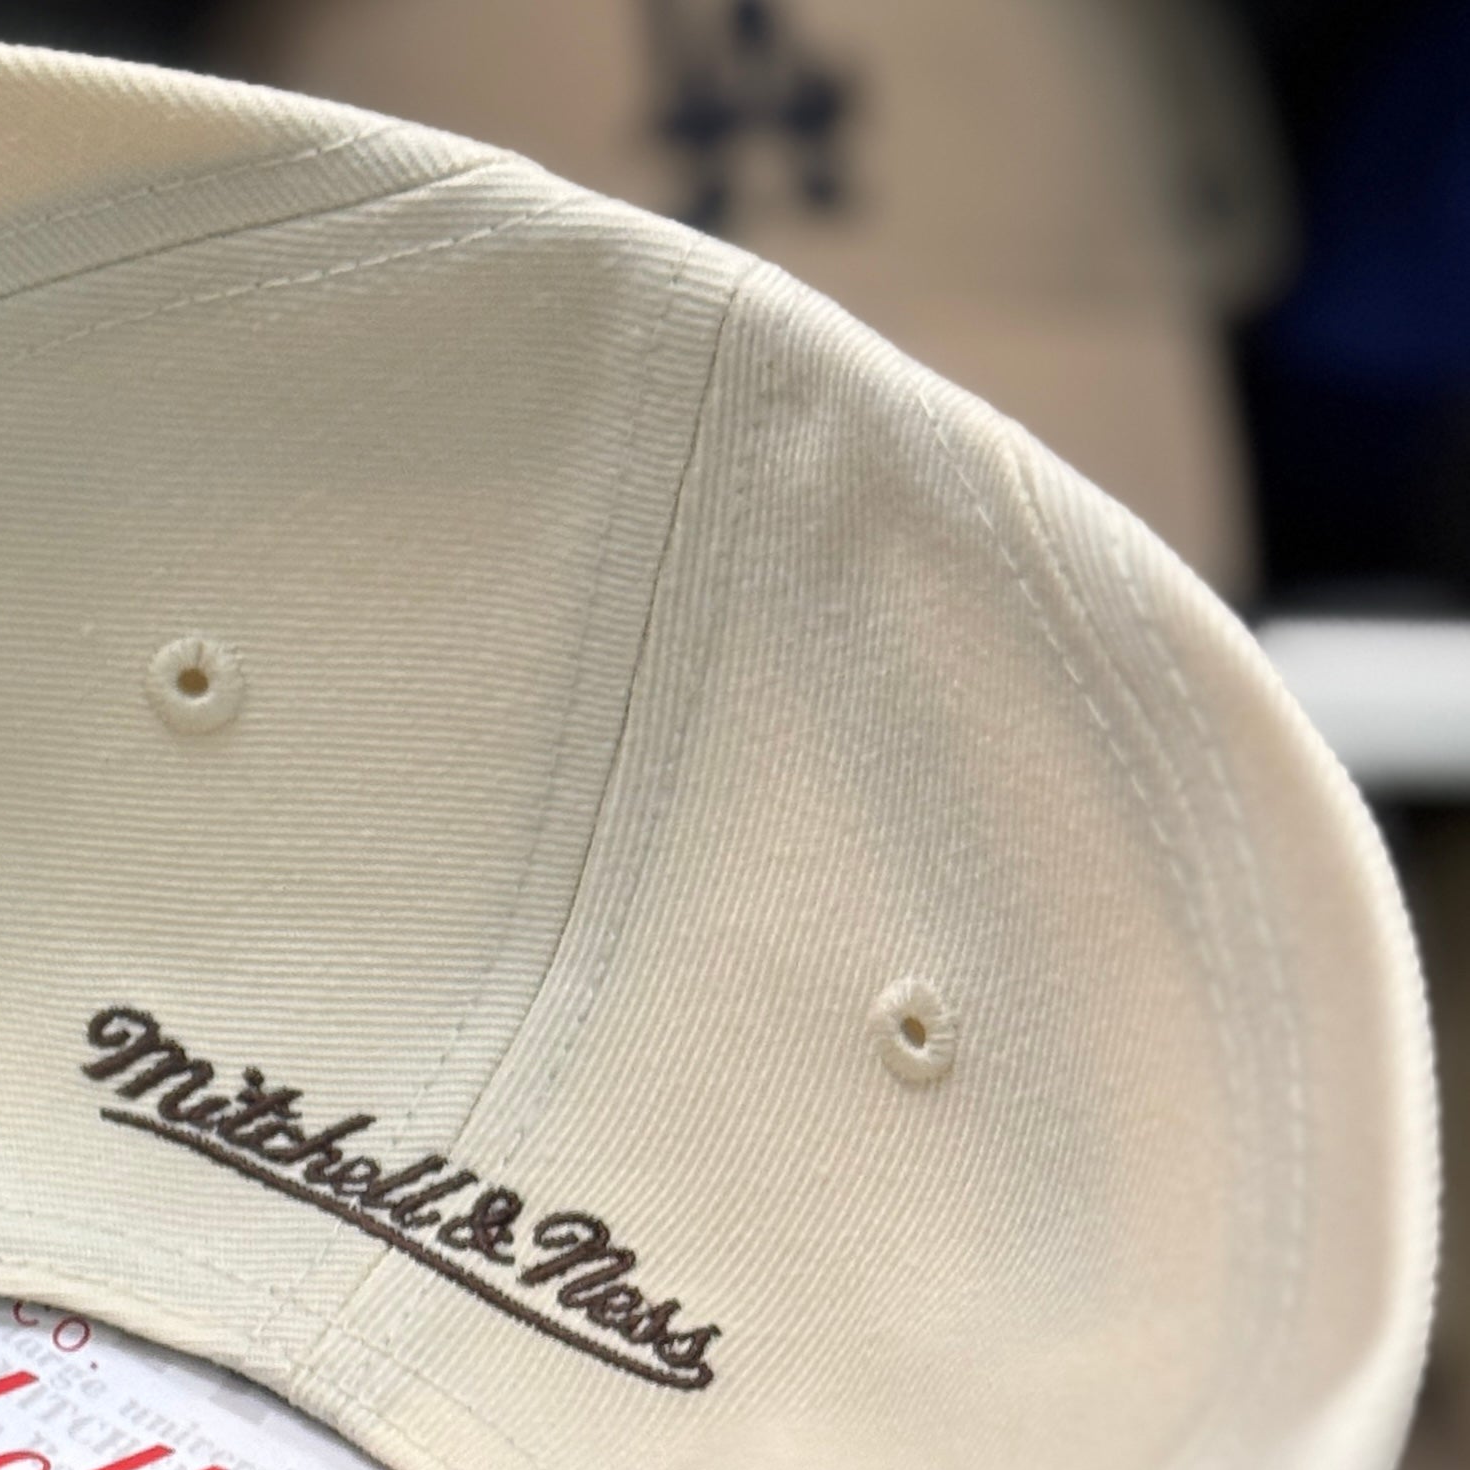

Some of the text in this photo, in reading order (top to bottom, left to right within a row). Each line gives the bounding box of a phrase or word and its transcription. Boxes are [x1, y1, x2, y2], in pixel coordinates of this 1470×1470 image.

[81, 1006, 722, 1369] Mitchell & Ness
